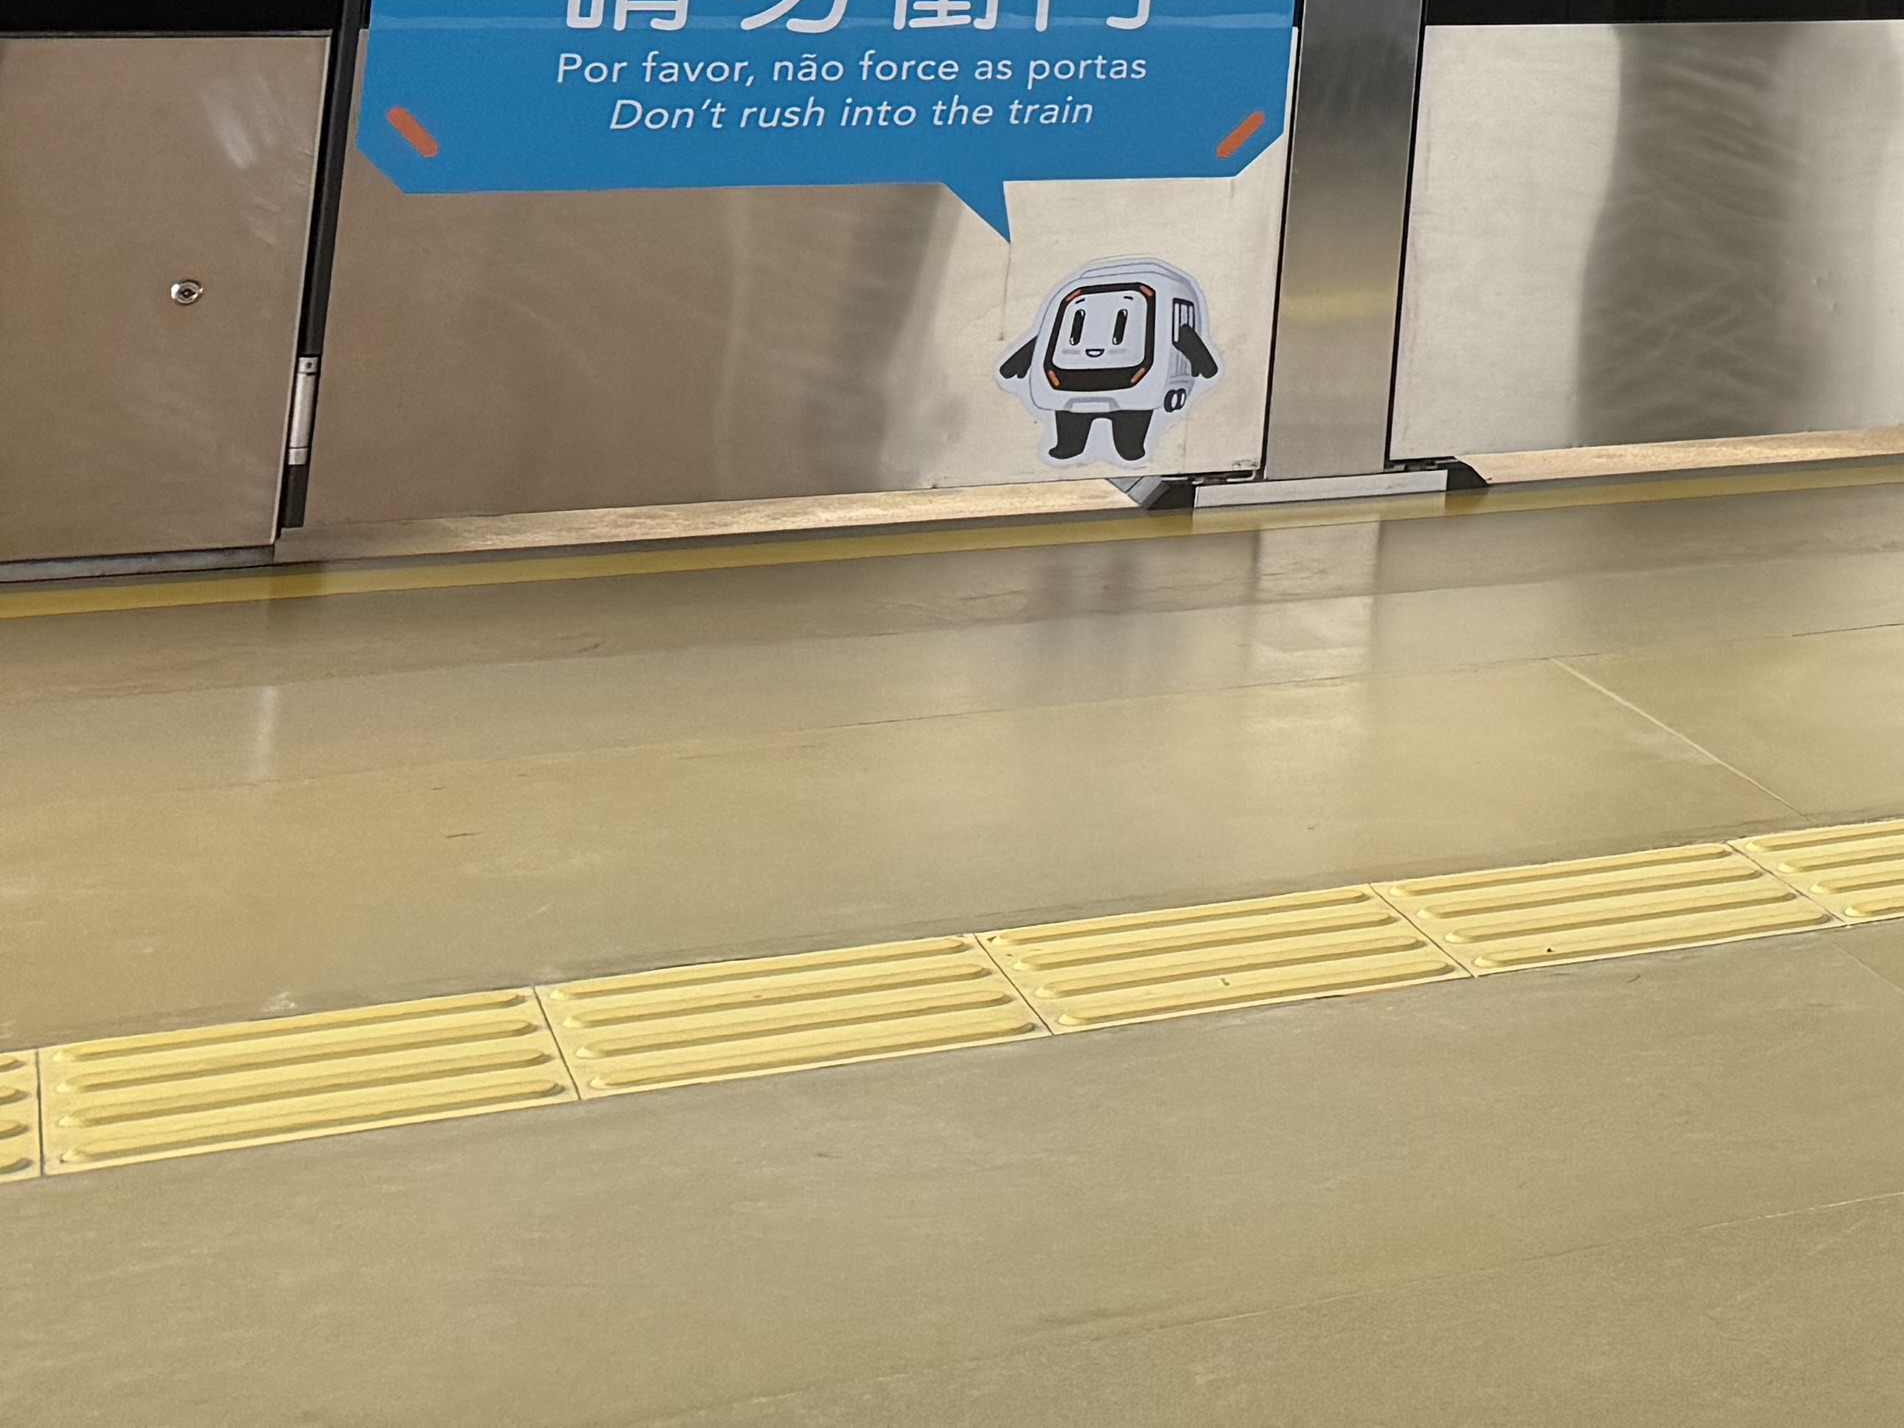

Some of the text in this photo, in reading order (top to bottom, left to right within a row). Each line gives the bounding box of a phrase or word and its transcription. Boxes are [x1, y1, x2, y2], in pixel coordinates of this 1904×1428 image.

[556, 50, 1148, 90] Por favor, não force as portas
[608, 95, 1094, 131] Don't rush into the train
